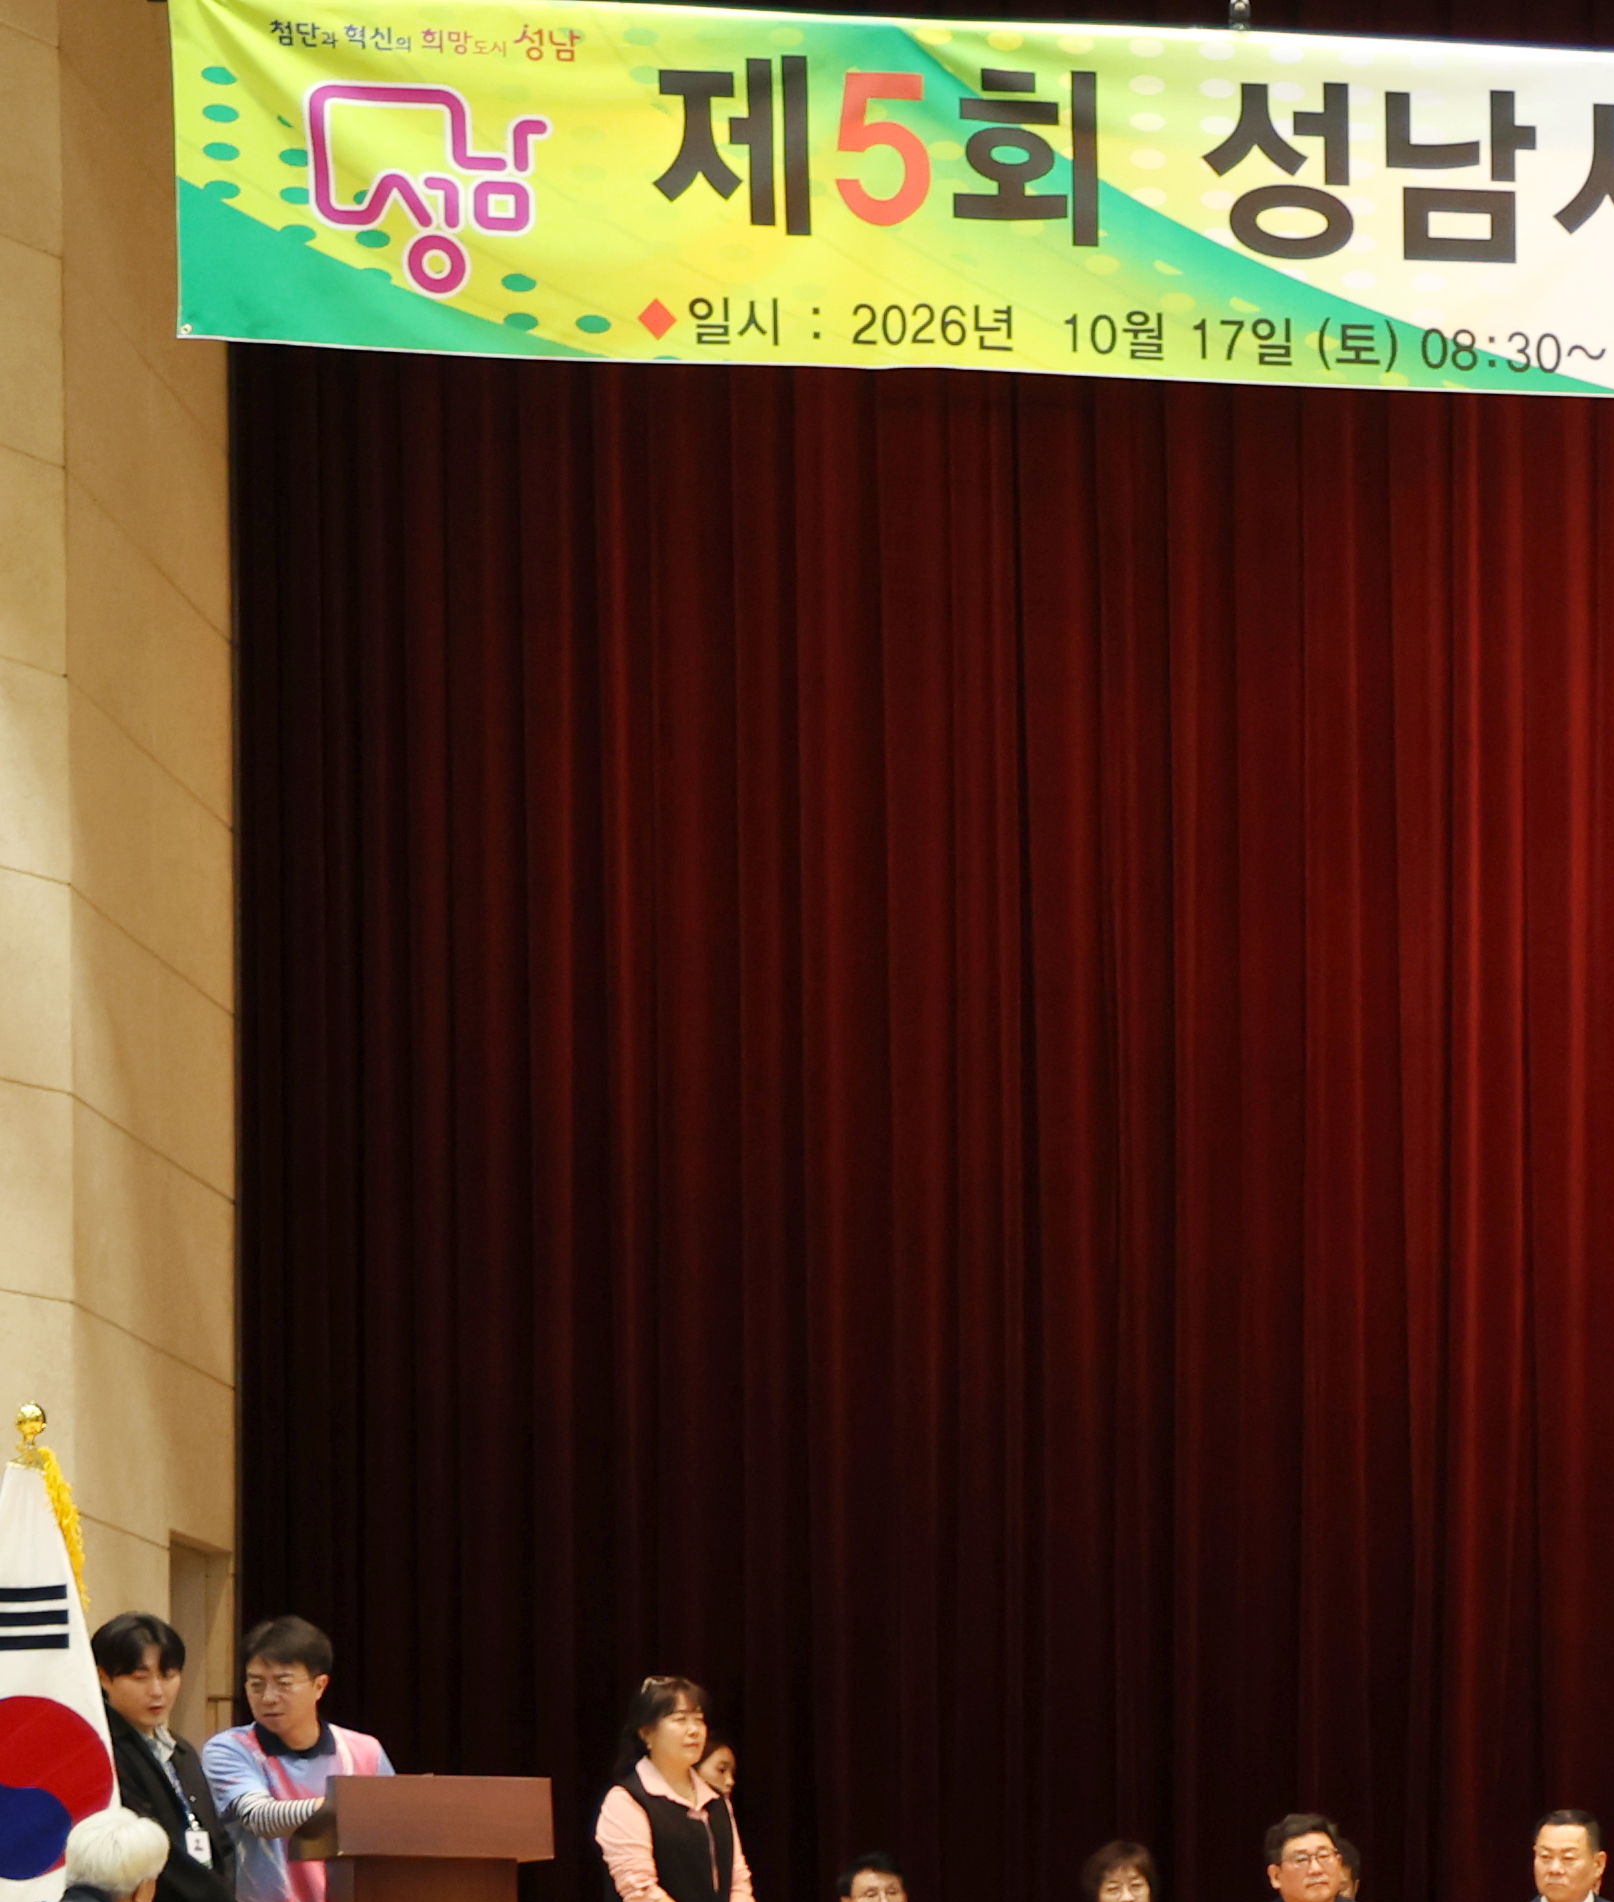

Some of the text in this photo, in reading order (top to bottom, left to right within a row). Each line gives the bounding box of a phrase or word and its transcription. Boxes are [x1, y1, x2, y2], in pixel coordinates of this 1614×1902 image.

[270, 19, 581, 62] 첨단과 혁신의 희망도시 성남
[653, 55, 1099, 247] 제5회
[688, 297, 781, 346] 일시
[852, 303, 1014, 352] 2026년
[1063, 310, 1166, 361] 10월
[1317, 317, 1399, 373] (토)
[1421, 328, 1606, 374] 08:30~
